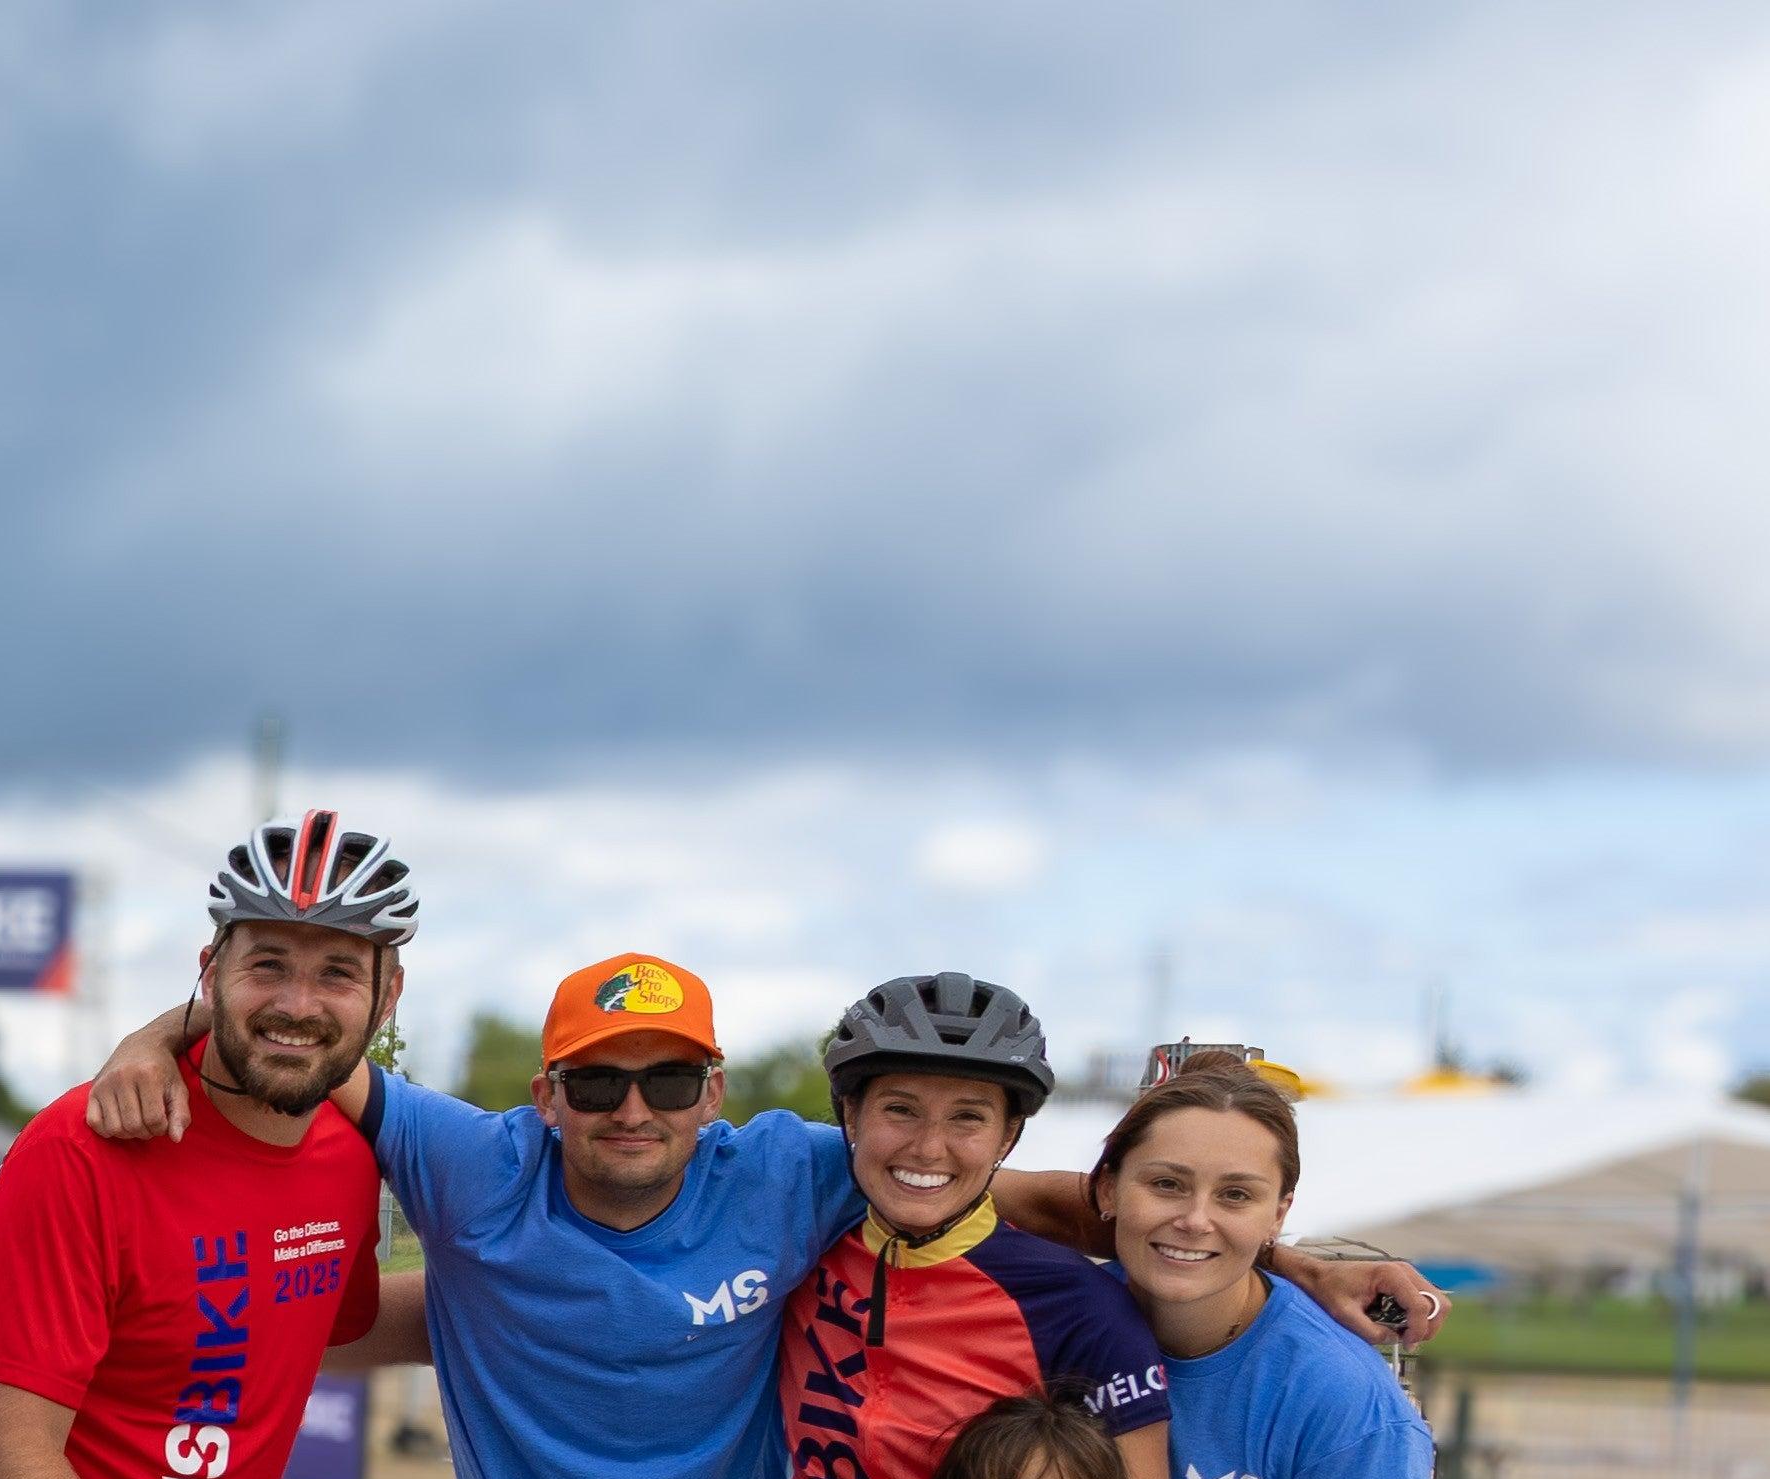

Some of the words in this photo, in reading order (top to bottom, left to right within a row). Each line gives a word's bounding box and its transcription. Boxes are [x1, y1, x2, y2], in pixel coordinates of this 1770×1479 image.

[634, 964, 668, 981] Bass
[638, 979, 662, 991] Pro
[637, 991, 679, 1008] Shops
[274, 1228, 289, 1244] Go
[290, 1225, 304, 1239] the
[305, 1219, 341, 1237] Distance.
[274, 1243, 299, 1262] Make
[300, 1245, 306, 1257] a
[307, 1238, 346, 1256] Difference.
[274, 1257, 340, 1304] 2025
[682, 1269, 767, 1326] MS
